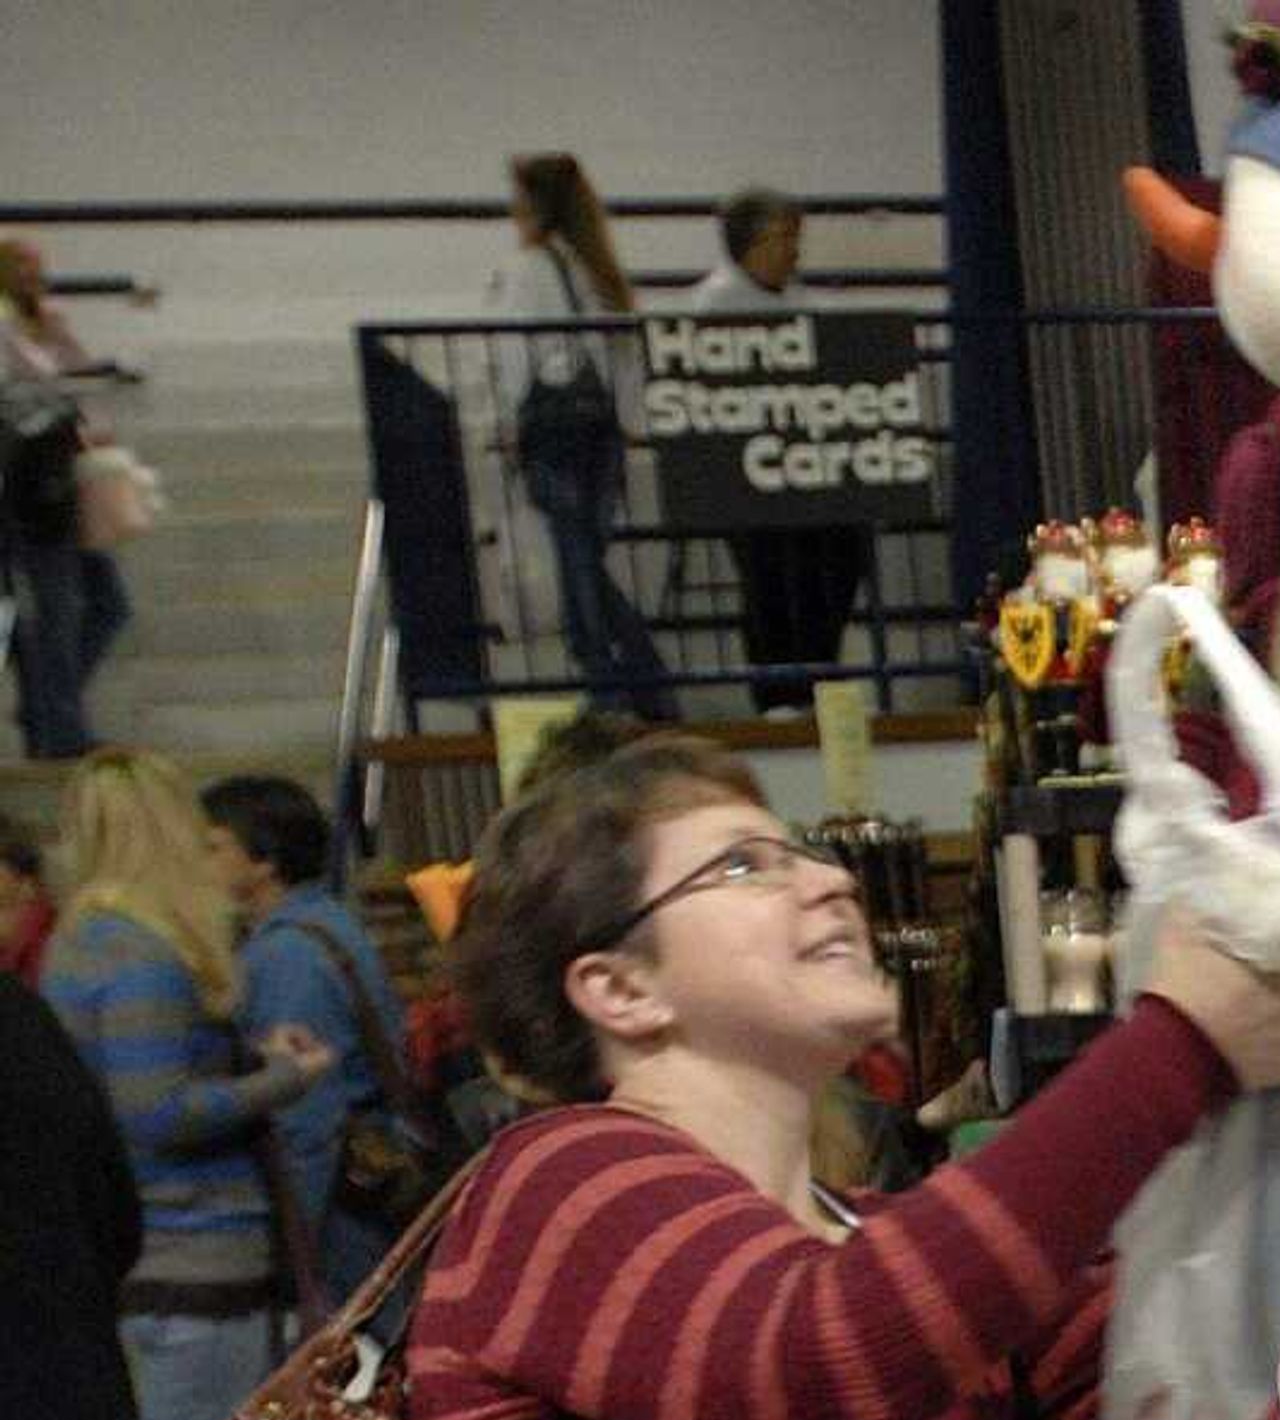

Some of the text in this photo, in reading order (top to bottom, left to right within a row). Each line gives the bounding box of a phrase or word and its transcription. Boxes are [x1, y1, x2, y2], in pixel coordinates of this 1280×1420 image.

[647, 314, 815, 374] Hand
[646, 371, 920, 440] Stamped
[742, 430, 933, 491] Cards
